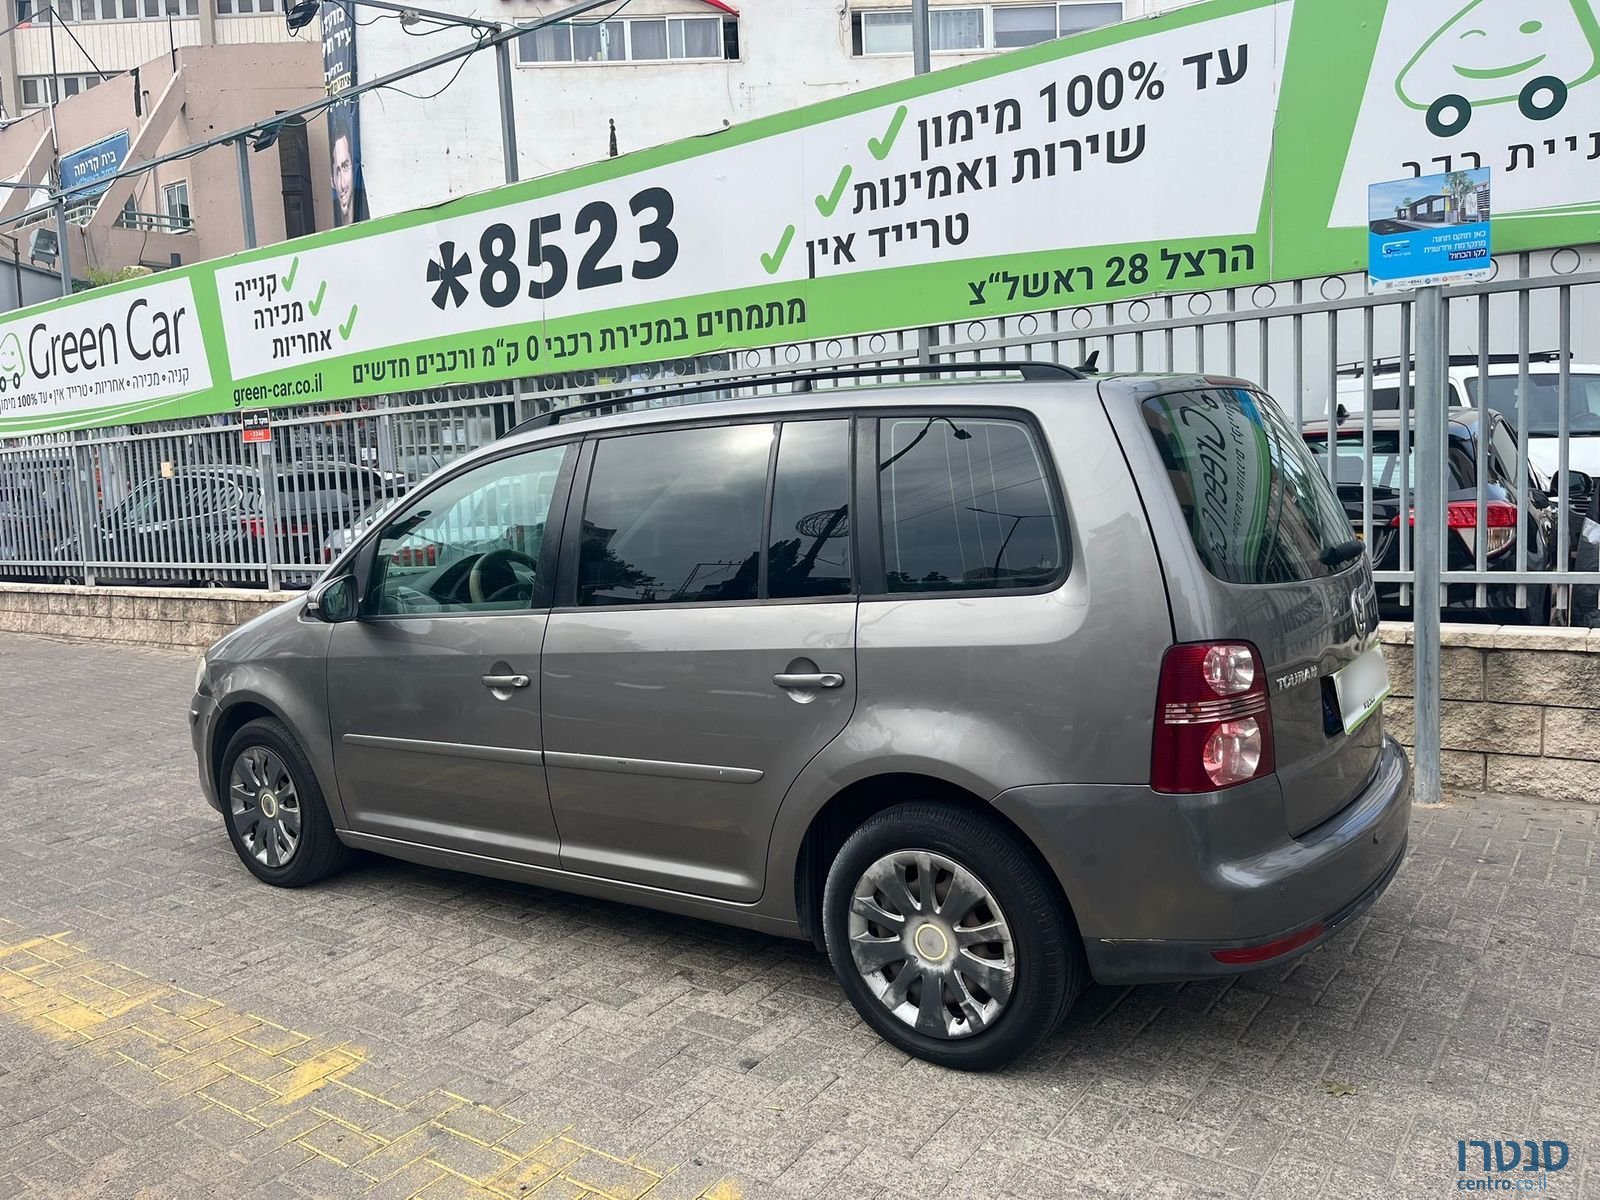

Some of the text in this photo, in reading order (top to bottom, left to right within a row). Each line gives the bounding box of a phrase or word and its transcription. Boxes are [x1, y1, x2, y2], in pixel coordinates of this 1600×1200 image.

[918, 43, 1248, 161] עד 100% מימון
[74, 156, 99, 177] קדימה
[101, 151, 117, 166] בית
[853, 124, 1146, 214] שירות ואמינות
[805, 212, 970, 279] טרייד אין
[1474, 230, 1486, 239] כאן
[1160, 243, 1255, 280] הרצל
[1450, 248, 1486, 260] לקו הכחול
[1105, 254, 1149, 288] 28
[235, 274, 277, 301] קנייה
[254, 301, 304, 330] מכירה
[697, 297, 807, 337] מתמחים
[28, 298, 186, 380] Green Car
[272, 329, 333, 359] אחריות
[526, 335, 539, 361] 0
[545, 332, 593, 359] רכבי
[600, 317, 689, 352] במכירת
[352, 357, 410, 384] חדשים
[416, 348, 475, 376] ורכבים
[95, 377, 125, 396] אחריות
[132, 372, 160, 389] מכירה
[168, 368, 190, 386] קניה
[233, 373, 323, 407] green-car.co.il
[18, 393, 38, 408] 100%
[38, 391, 48, 404] עד
[53, 388, 65, 405] אין
[66, 384, 88, 399] טרייד
[1275, 665, 1318, 692] TOURAN
